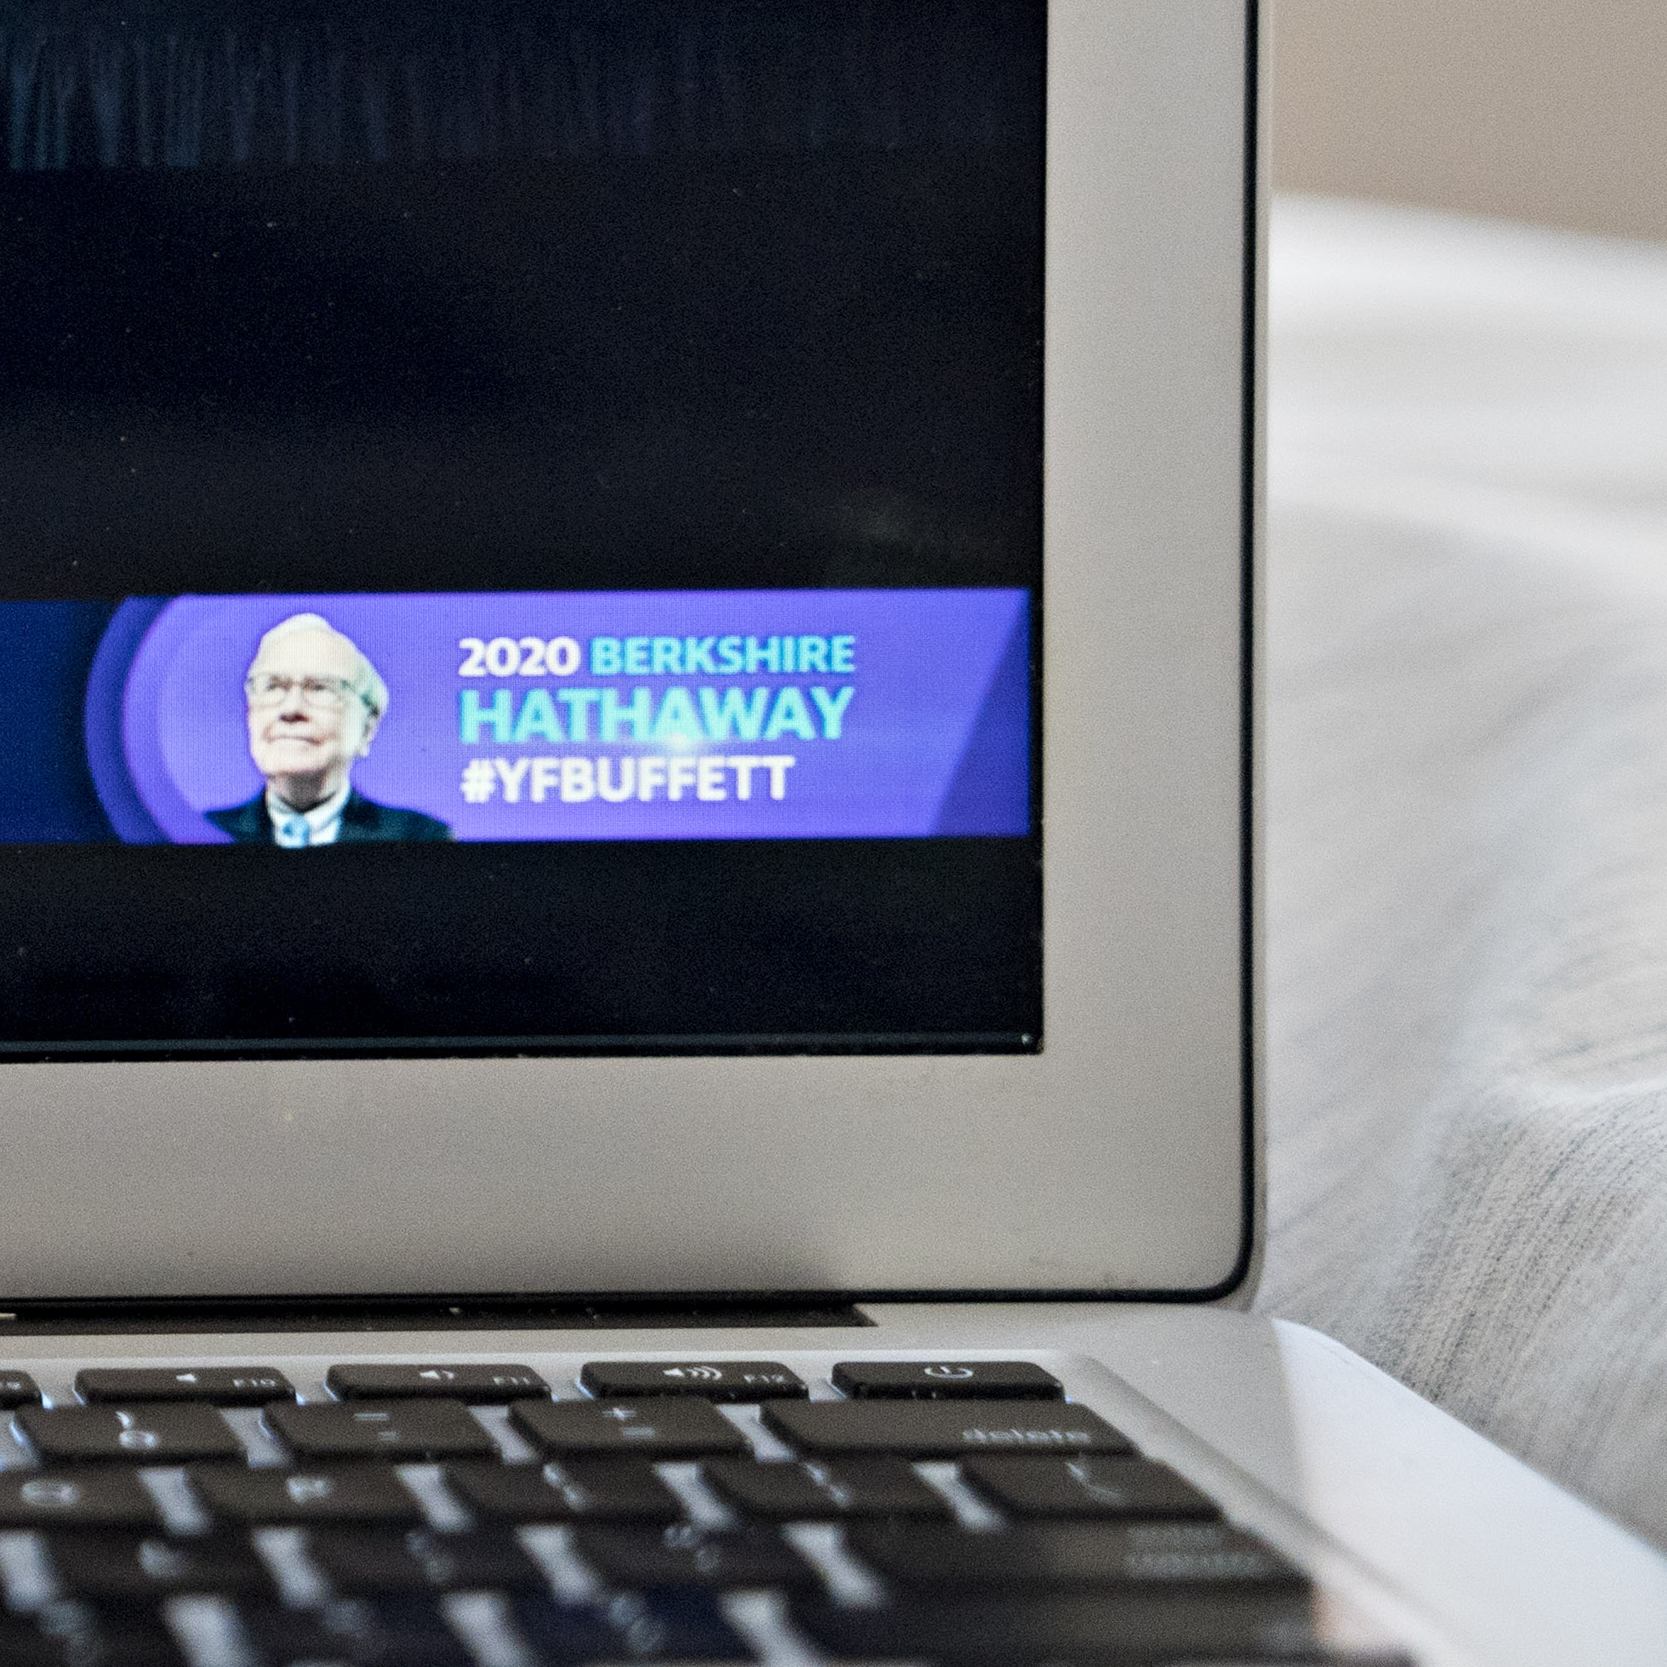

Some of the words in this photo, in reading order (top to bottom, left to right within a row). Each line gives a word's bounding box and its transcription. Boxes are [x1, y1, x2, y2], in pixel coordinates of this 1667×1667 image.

[458, 636, 581, 677] 2020
[590, 636, 855, 675] BERKSHIRE
[459, 686, 855, 745] HATHAWAY
[460, 753, 797, 804] #YFBUFFETT
